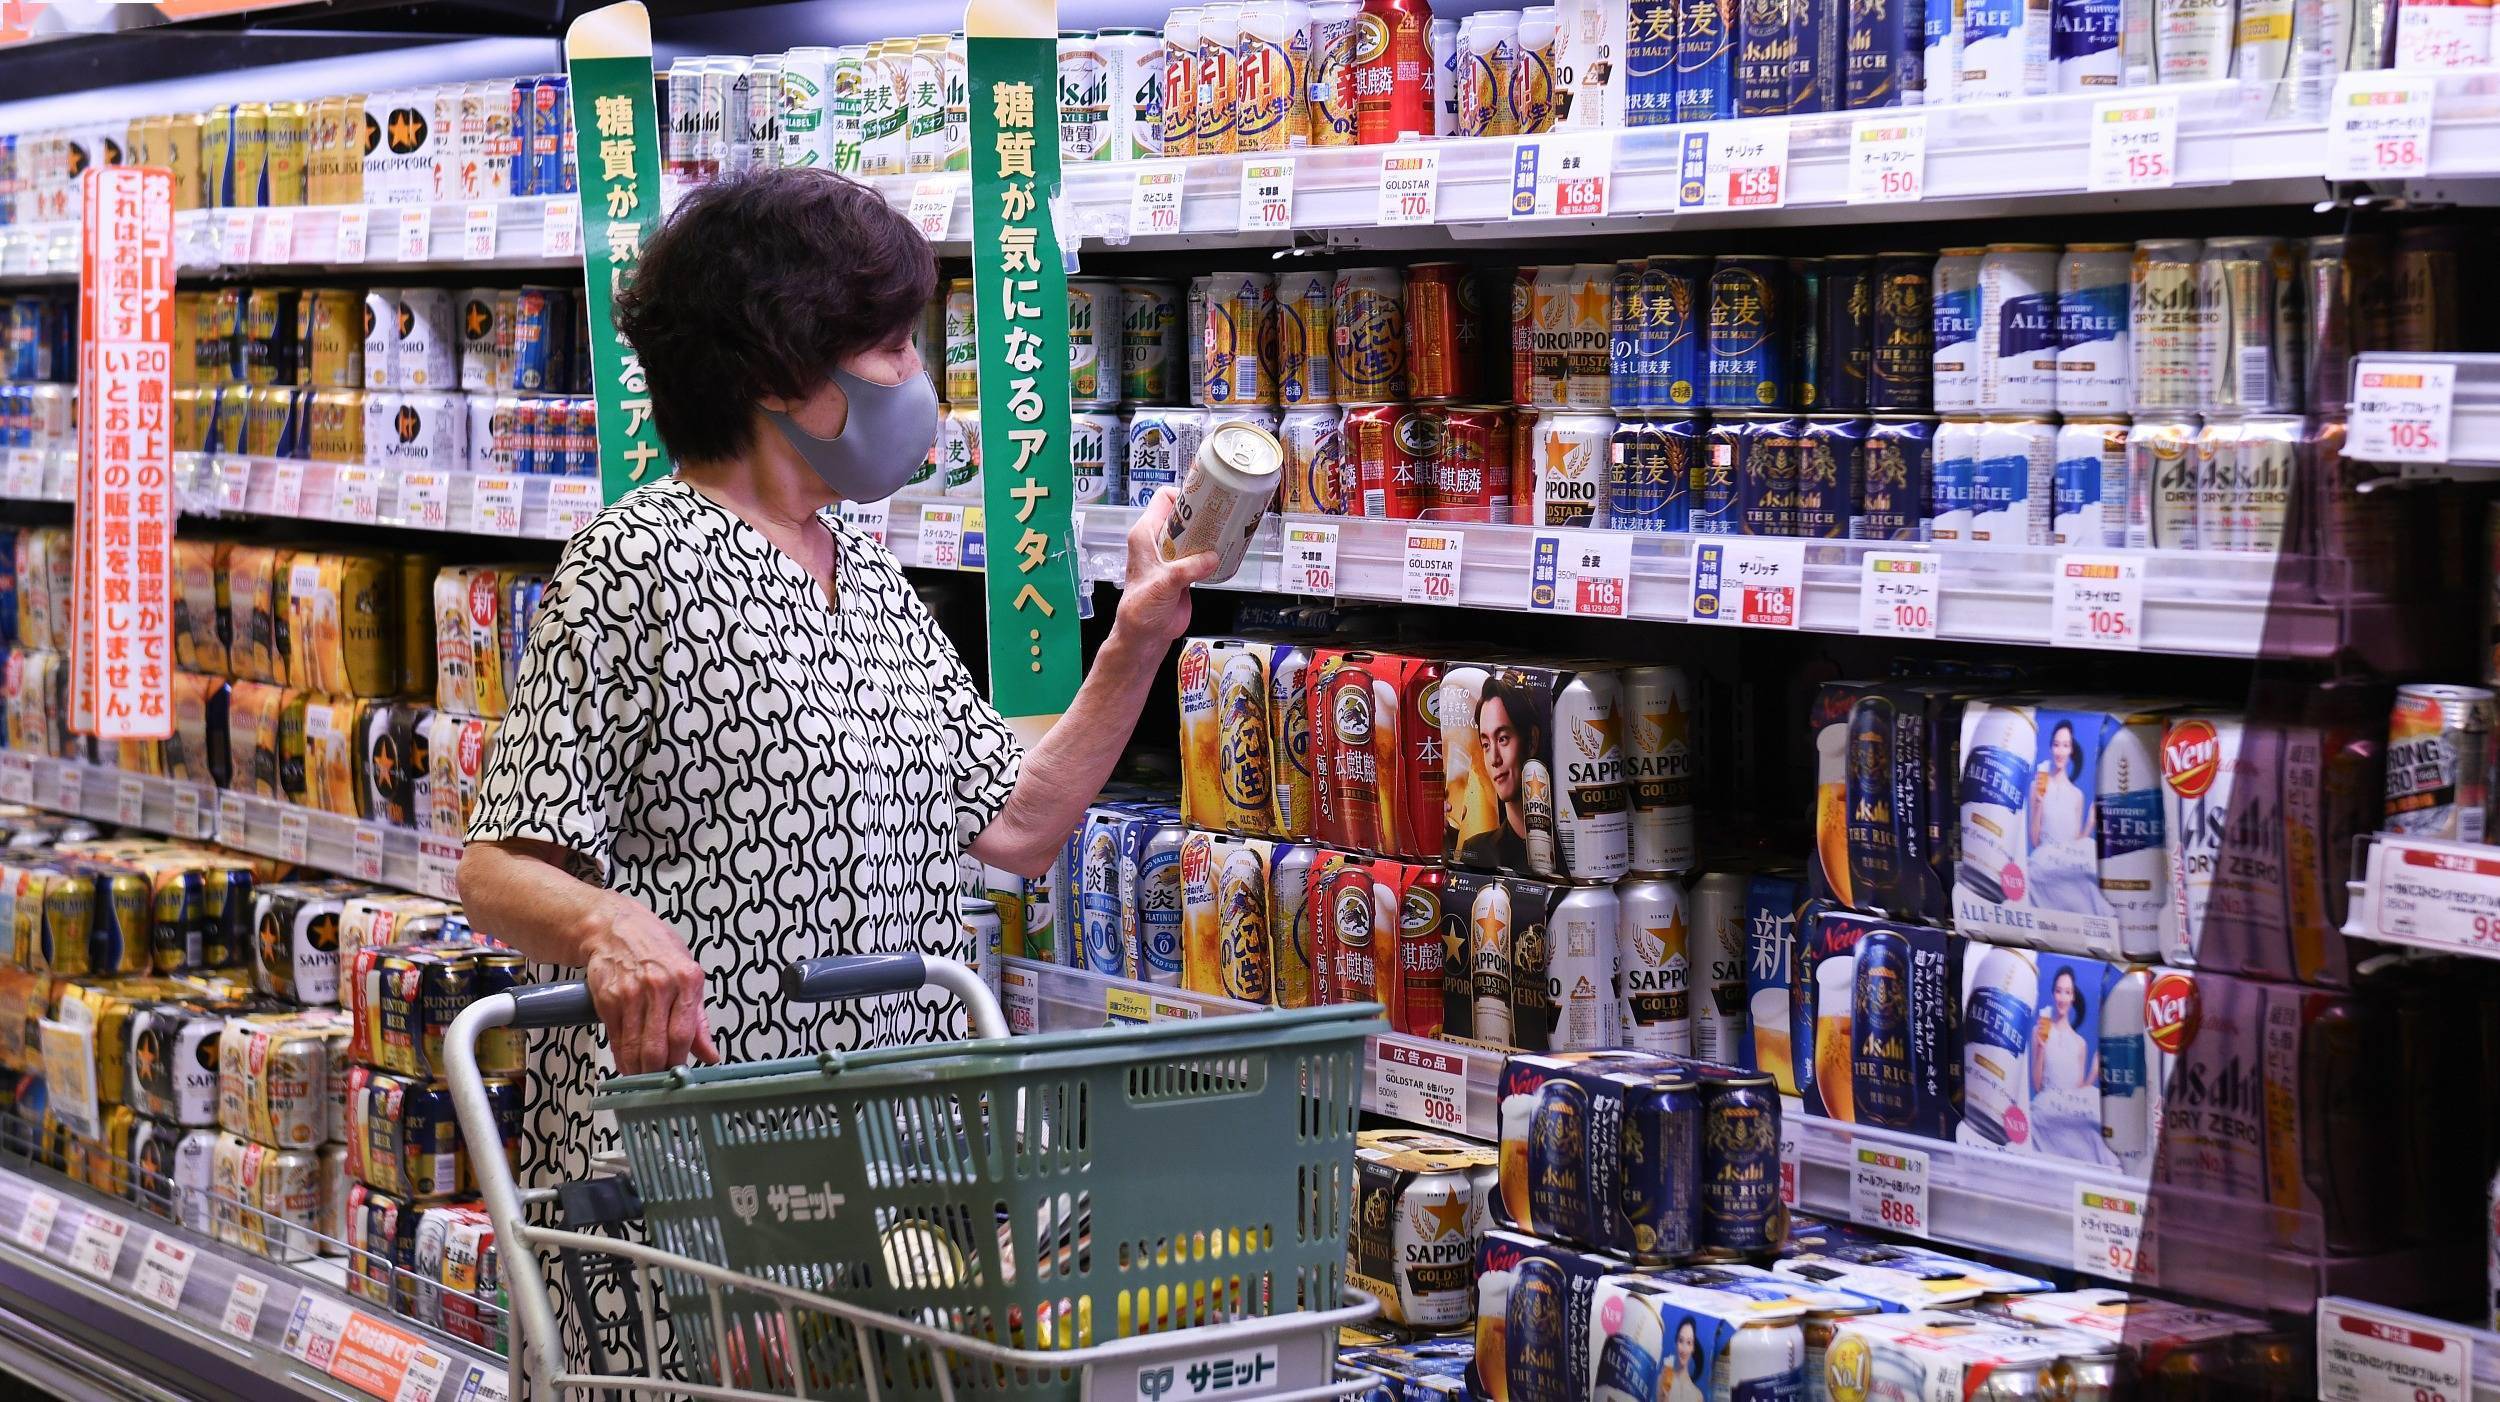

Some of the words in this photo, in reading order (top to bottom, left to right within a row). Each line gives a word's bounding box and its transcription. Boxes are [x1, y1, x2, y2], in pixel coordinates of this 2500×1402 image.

[1725, 144, 1765, 158] ザ・リッチ
[1863, 151, 1915, 164] オールフリー
[1562, 157, 1580, 168] 金麦
[1385, 179, 1430, 190] GOLDSTAR
[1142, 192, 1173, 203] のどごし生
[113, 174, 139, 336] これはお酒です
[1709, 295, 1761, 327] 金麦
[1211, 384, 1229, 396] お酒
[1285, 385, 1302, 397] お酒
[1671, 385, 1693, 399] お酒
[104, 350, 130, 731] いとお酒の販売を致しません。
[136, 350, 166, 716] 20歳以上の年齢確認ができな
[923, 528, 958, 538] スタイルフリー
[1409, 559, 1453, 571] GOLDSTAR
[1581, 554, 1601, 567] 金麦
[1738, 562, 1780, 576] ザ・リッチ
[1305, 569, 1334, 590] 120円
[1423, 577, 1454, 597] 120円
[1876, 584, 1930, 596] オールフリー
[472, 584, 496, 619] 新
[1587, 584, 1621, 604] 118円
[1754, 592, 1792, 613] 118円
[1416, 736, 1443, 766] 本
[2164, 735, 2219, 777] New
[1333, 749, 1377, 786] 本麒麟
[1960, 902, 2034, 930] ALL-FREE
[1751, 907, 1796, 985] 新
[1333, 950, 1376, 987] 本麒麟
[1393, 1048, 1447, 1071] 広告の品
[1385, 1074, 1424, 1091] GOLDSTAR
[1427, 1083, 1455, 1097] 6缶パック
[1424, 1098, 1462, 1125] 908円
[766, 1180, 846, 1222] サミット
[1186, 1352, 1275, 1393] サミット
